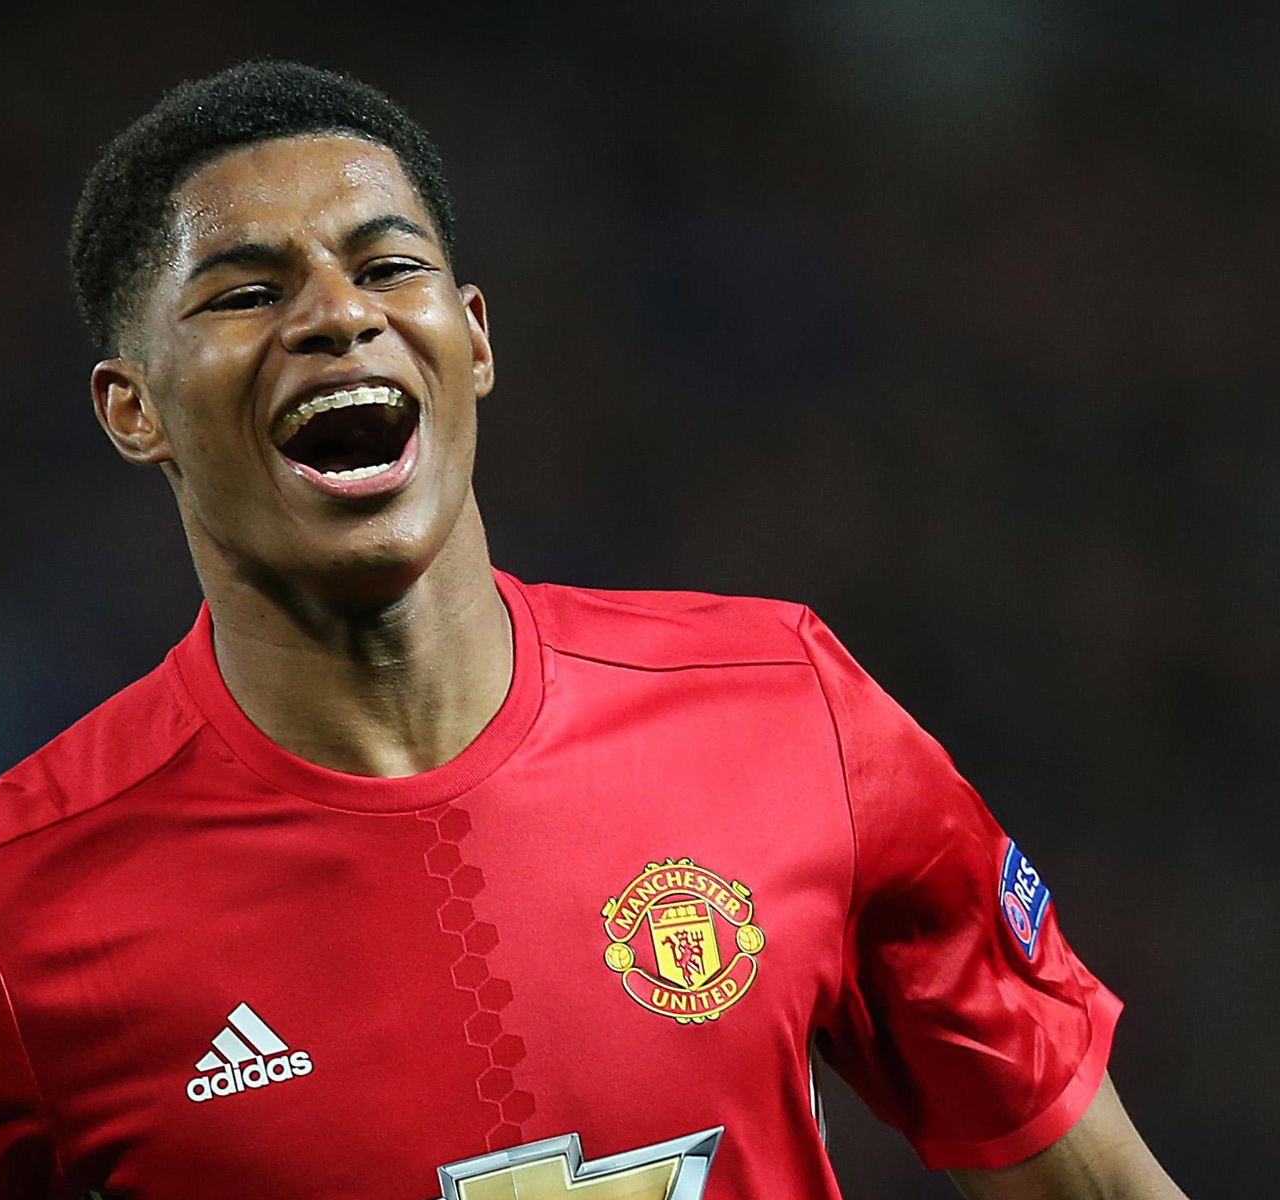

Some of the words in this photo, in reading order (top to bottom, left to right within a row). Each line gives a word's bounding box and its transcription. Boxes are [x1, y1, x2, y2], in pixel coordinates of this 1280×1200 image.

[615, 870, 742, 930] MANCHESTER
[651, 978, 738, 1011] UNITED
[186, 1051, 314, 1102] adidas
